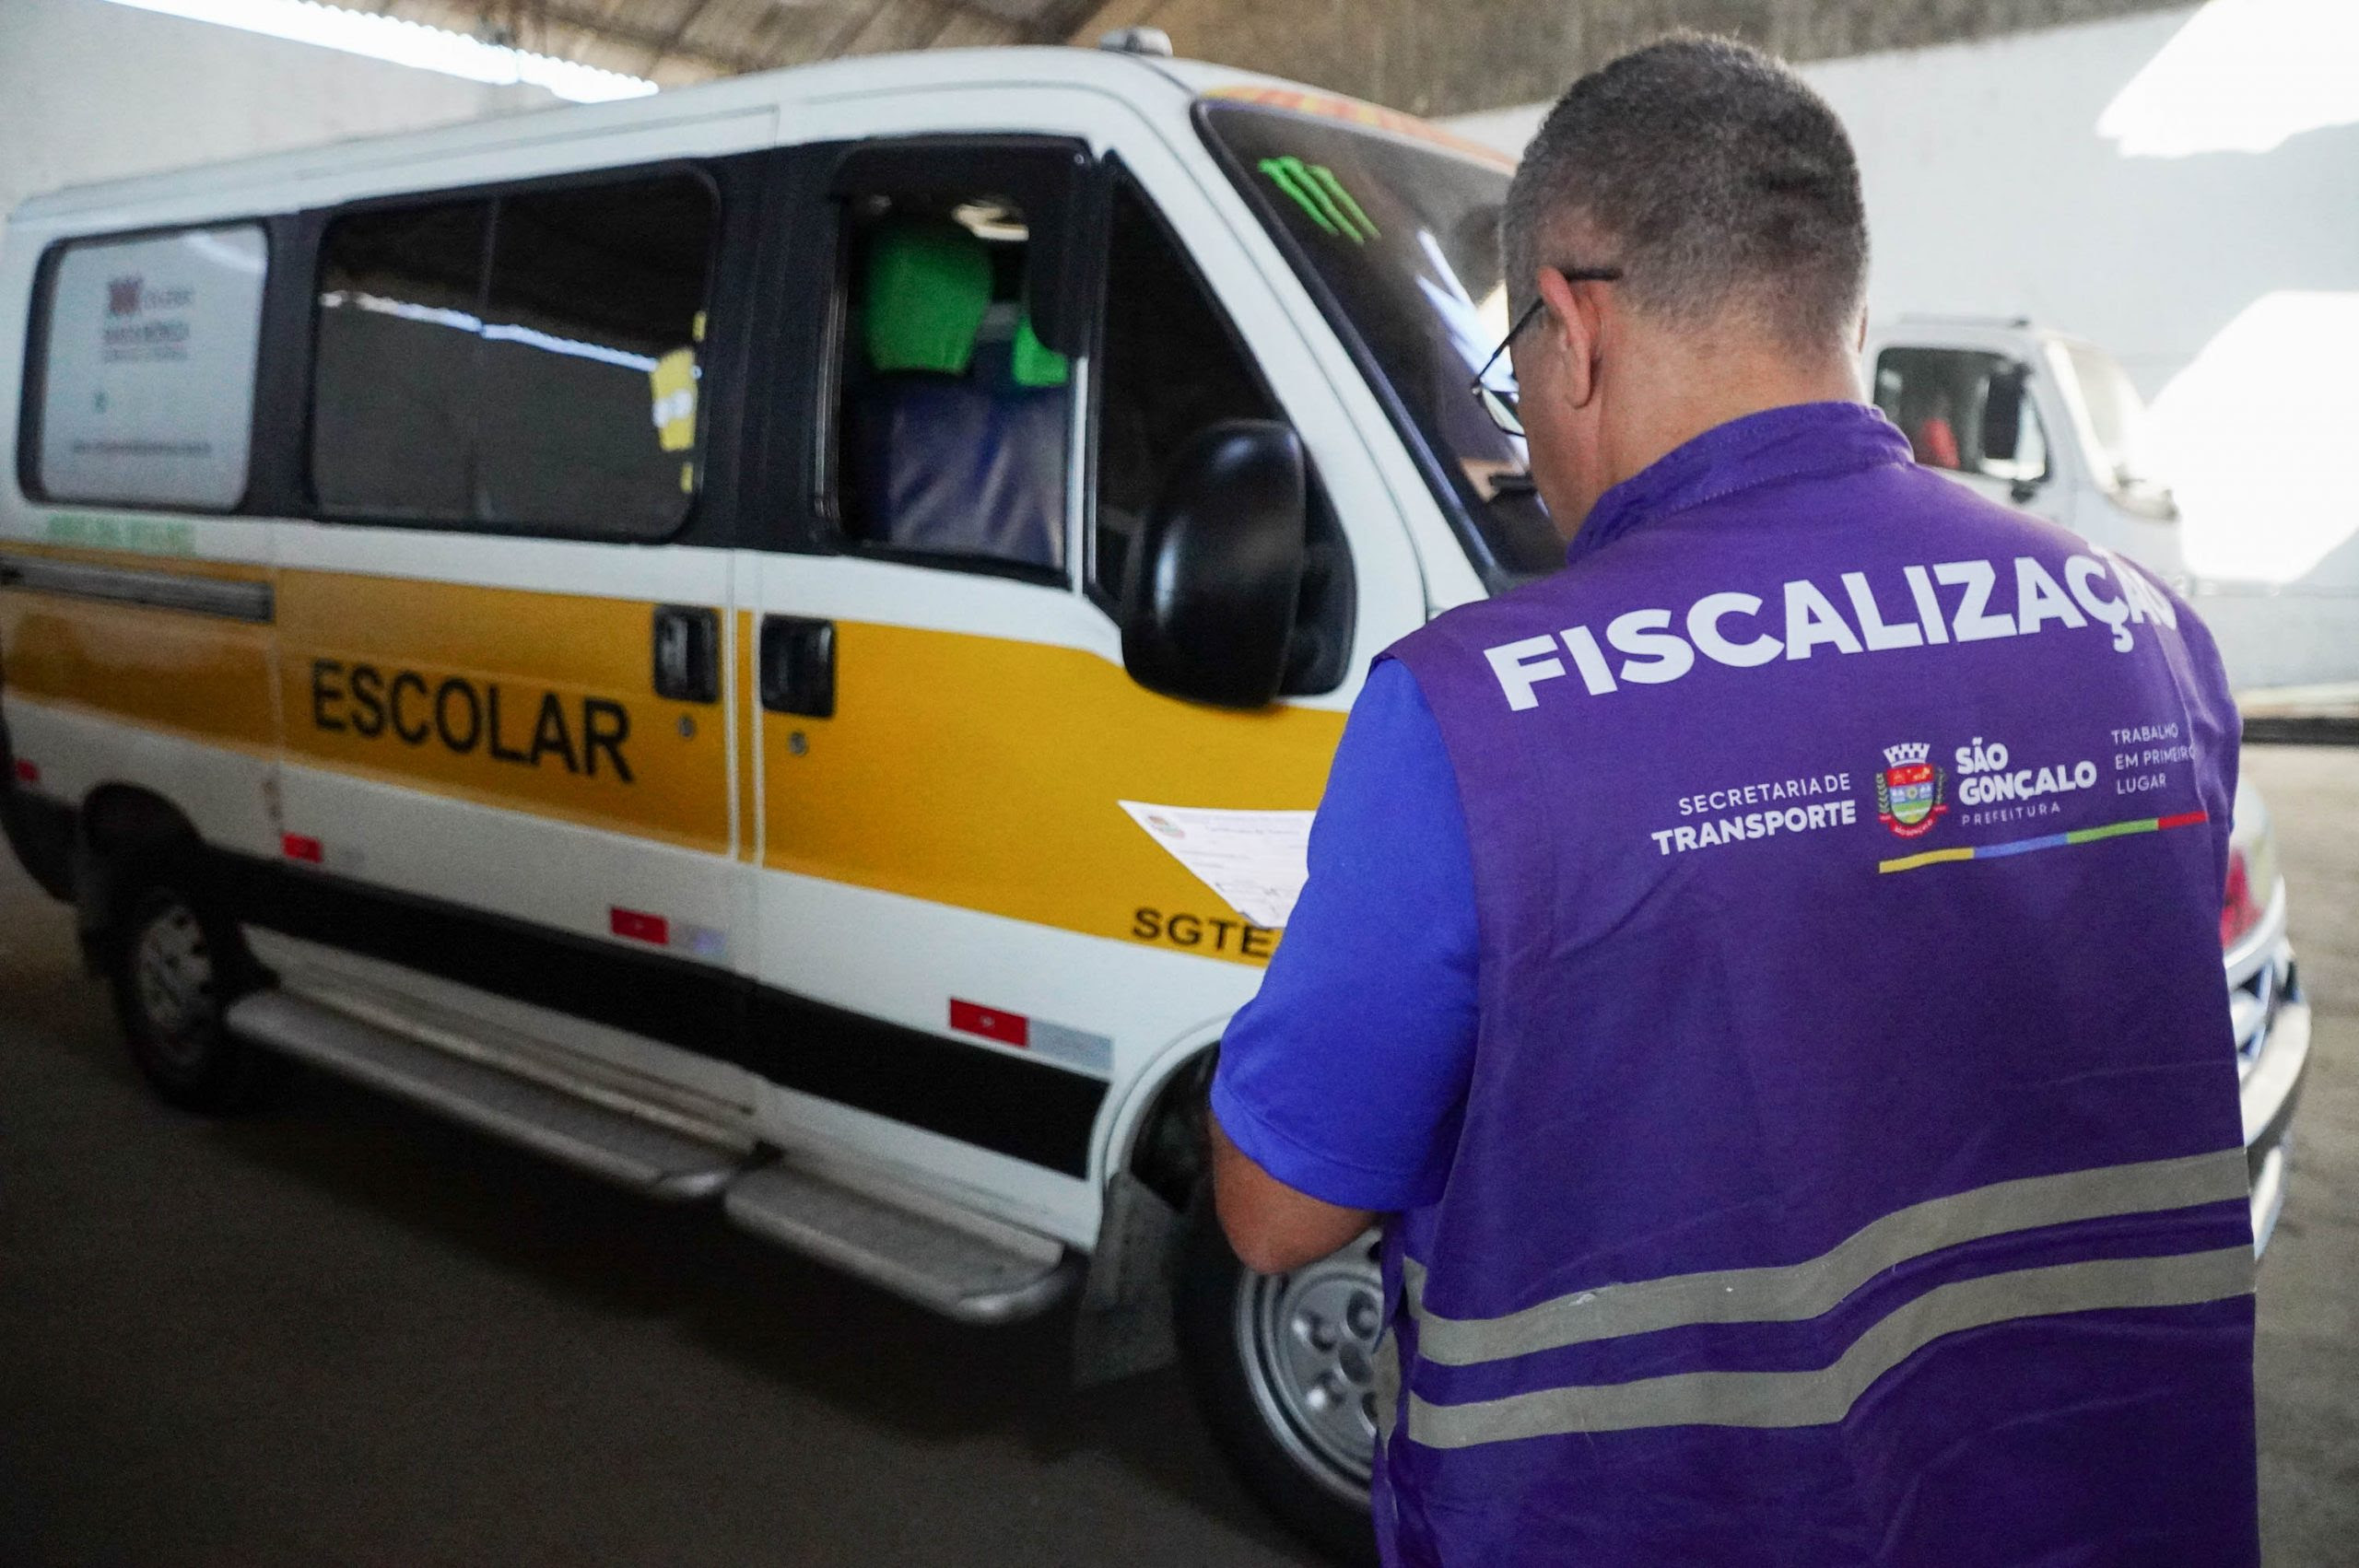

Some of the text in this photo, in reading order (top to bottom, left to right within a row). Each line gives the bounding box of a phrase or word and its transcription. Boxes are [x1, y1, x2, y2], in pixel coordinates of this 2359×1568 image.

[311, 658, 634, 784] ESCOLAR
[2111, 722, 2178, 744] TRABALHO
[1955, 737, 2009, 775] SÃO
[2115, 753, 2139, 770] EM
[1958, 760, 2097, 805] GONÇALO
[2117, 773, 2166, 795] LUGAR
[1651, 800, 1857, 855] TRANSPORTE
[1962, 802, 2061, 825] PREFEITURA
[1132, 907, 1273, 958] SGTE
